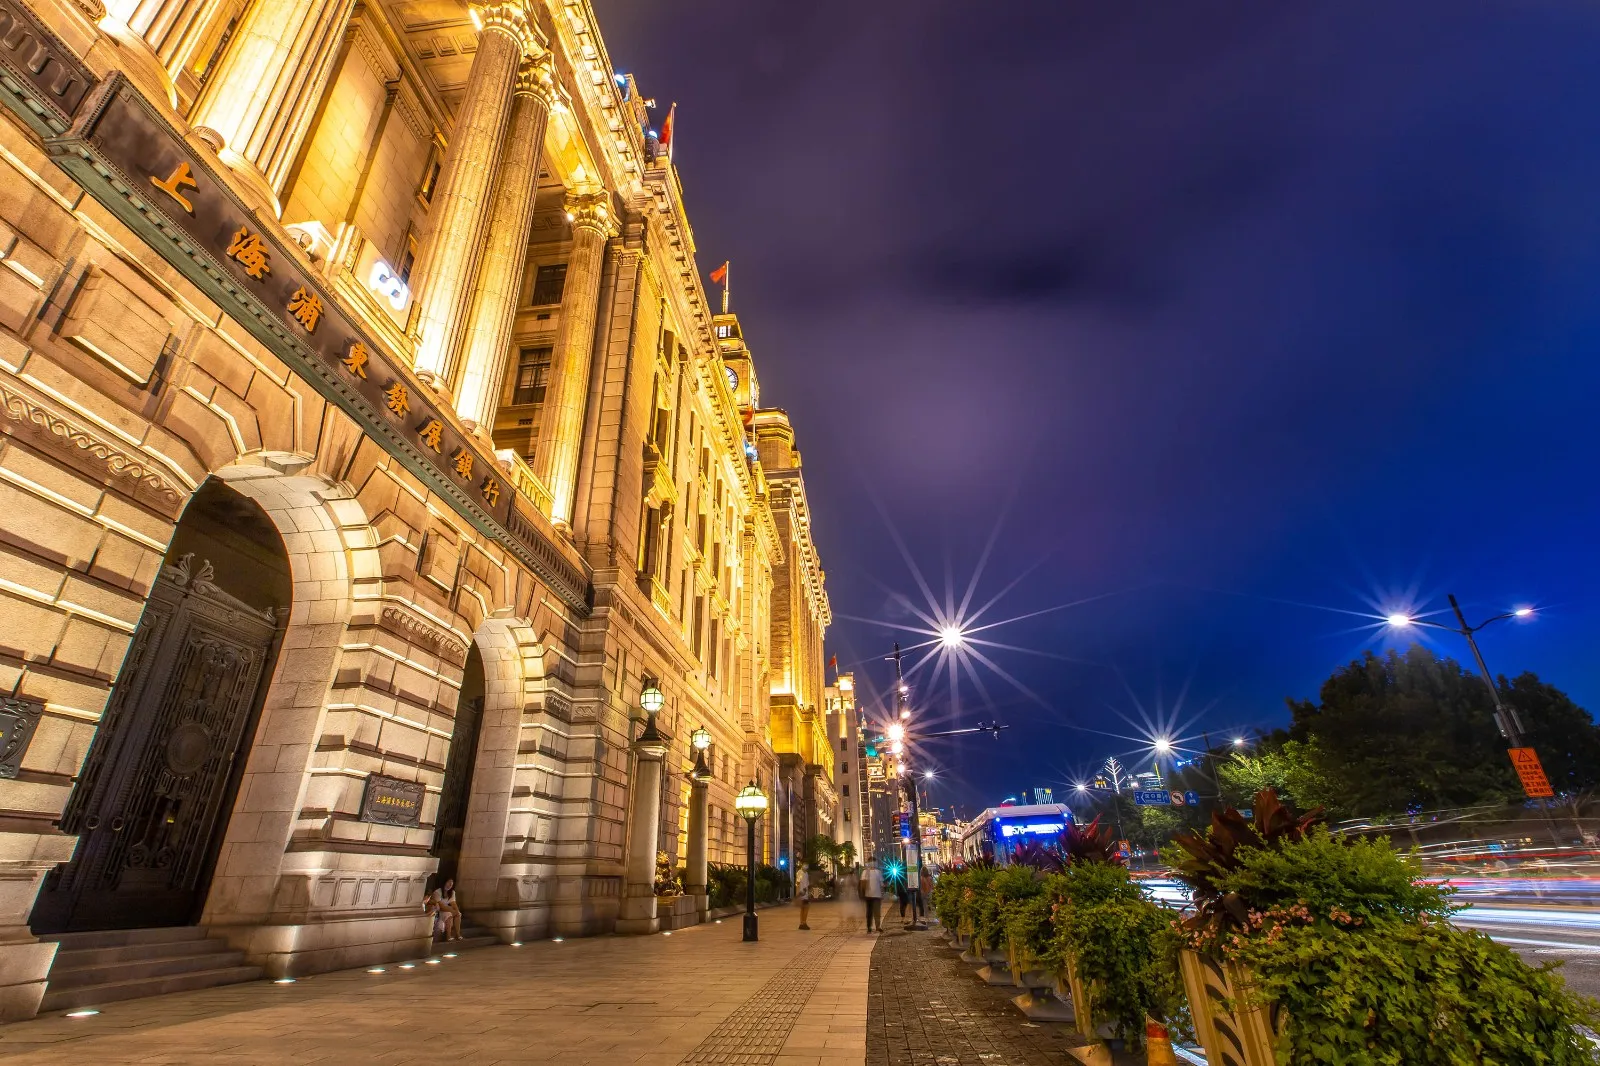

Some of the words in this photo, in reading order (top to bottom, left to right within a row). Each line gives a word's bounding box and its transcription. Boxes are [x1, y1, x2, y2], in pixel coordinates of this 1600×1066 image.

[151, 161, 500, 507] 上海浦東發展銀行
